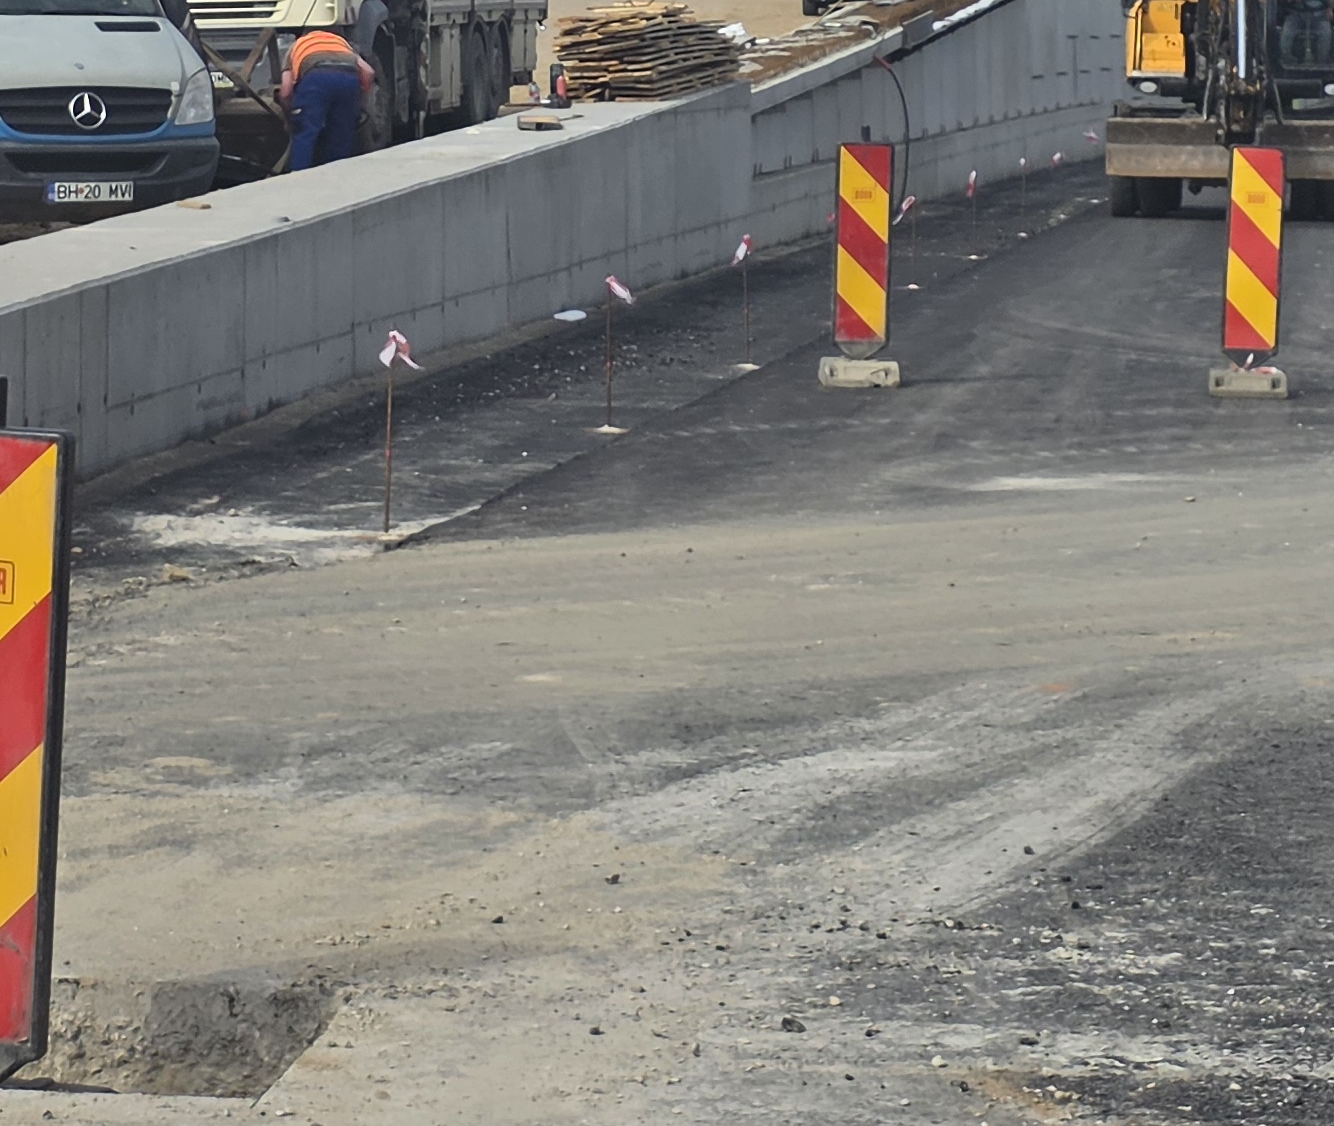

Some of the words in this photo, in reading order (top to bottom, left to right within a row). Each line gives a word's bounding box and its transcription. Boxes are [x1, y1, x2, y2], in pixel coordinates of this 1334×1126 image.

[57, 184, 79, 200] BH
[83, 184, 102, 200] 20
[108, 183, 132, 199] MVI
